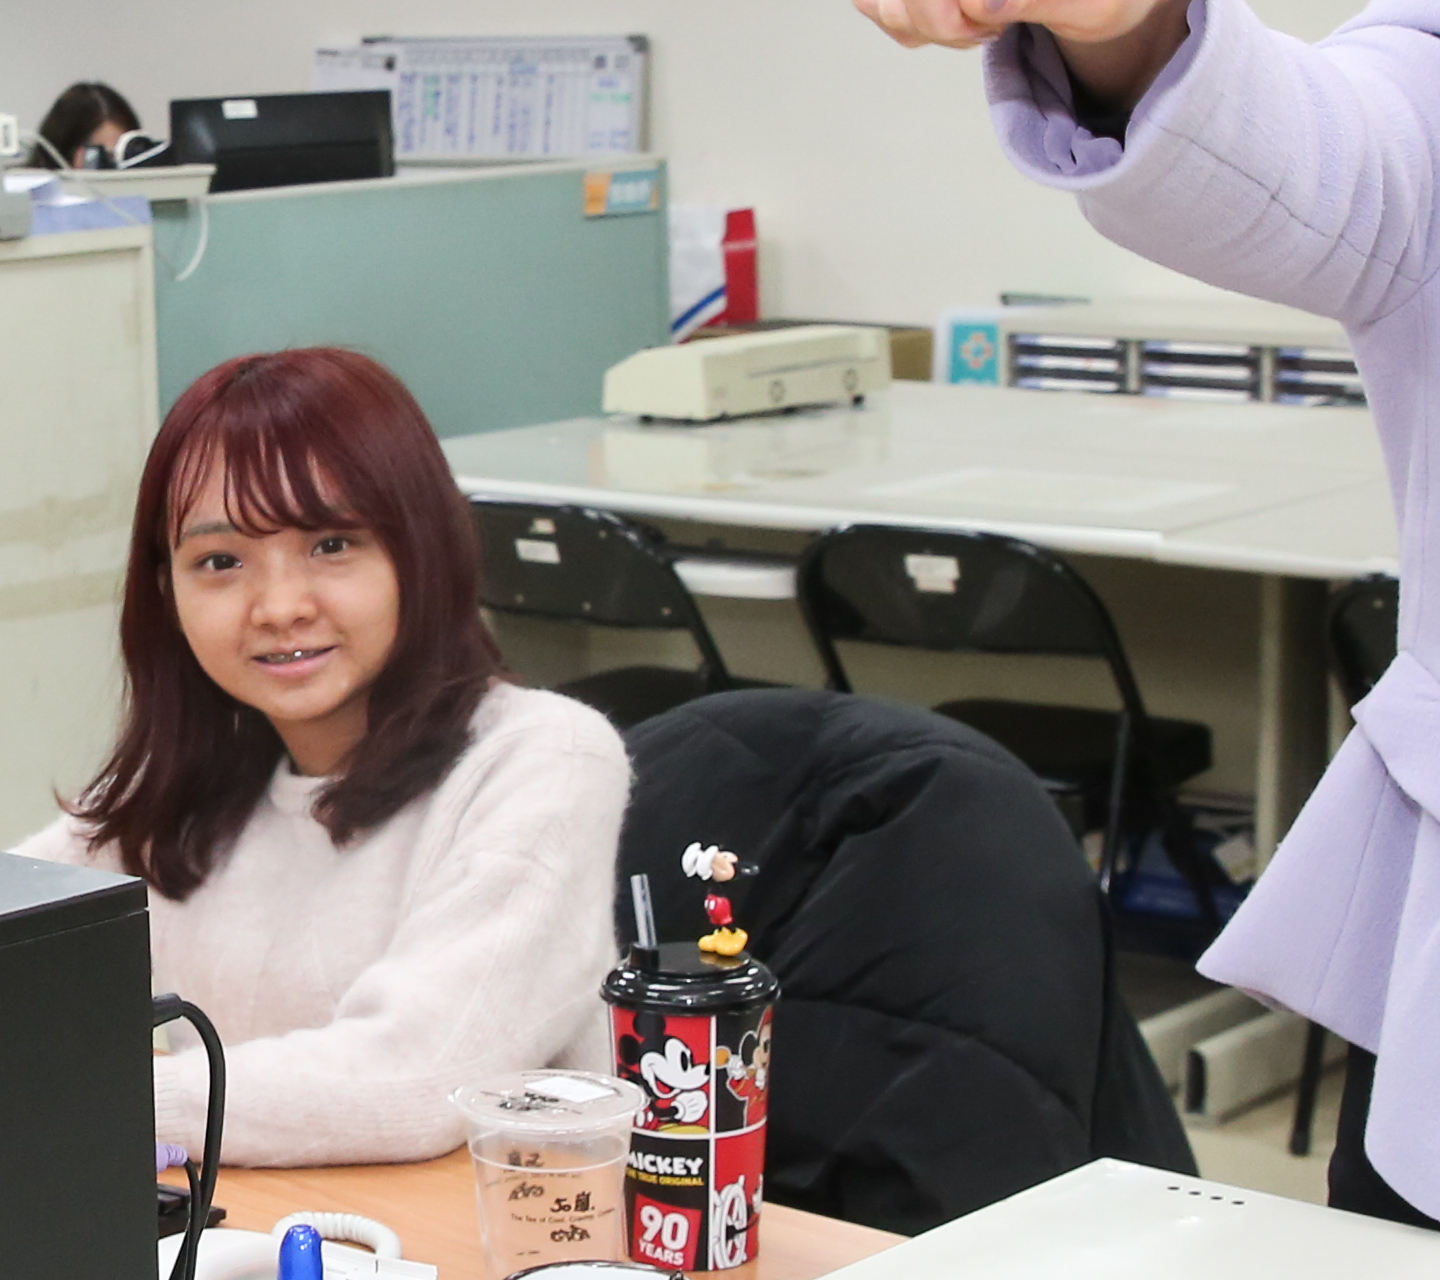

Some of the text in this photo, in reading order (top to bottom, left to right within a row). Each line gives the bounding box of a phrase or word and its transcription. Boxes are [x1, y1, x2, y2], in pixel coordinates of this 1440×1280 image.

[627, 1150, 704, 1176] MICKEY
[640, 1205, 689, 1250] 90
[637, 1240, 684, 1266] YEARS
